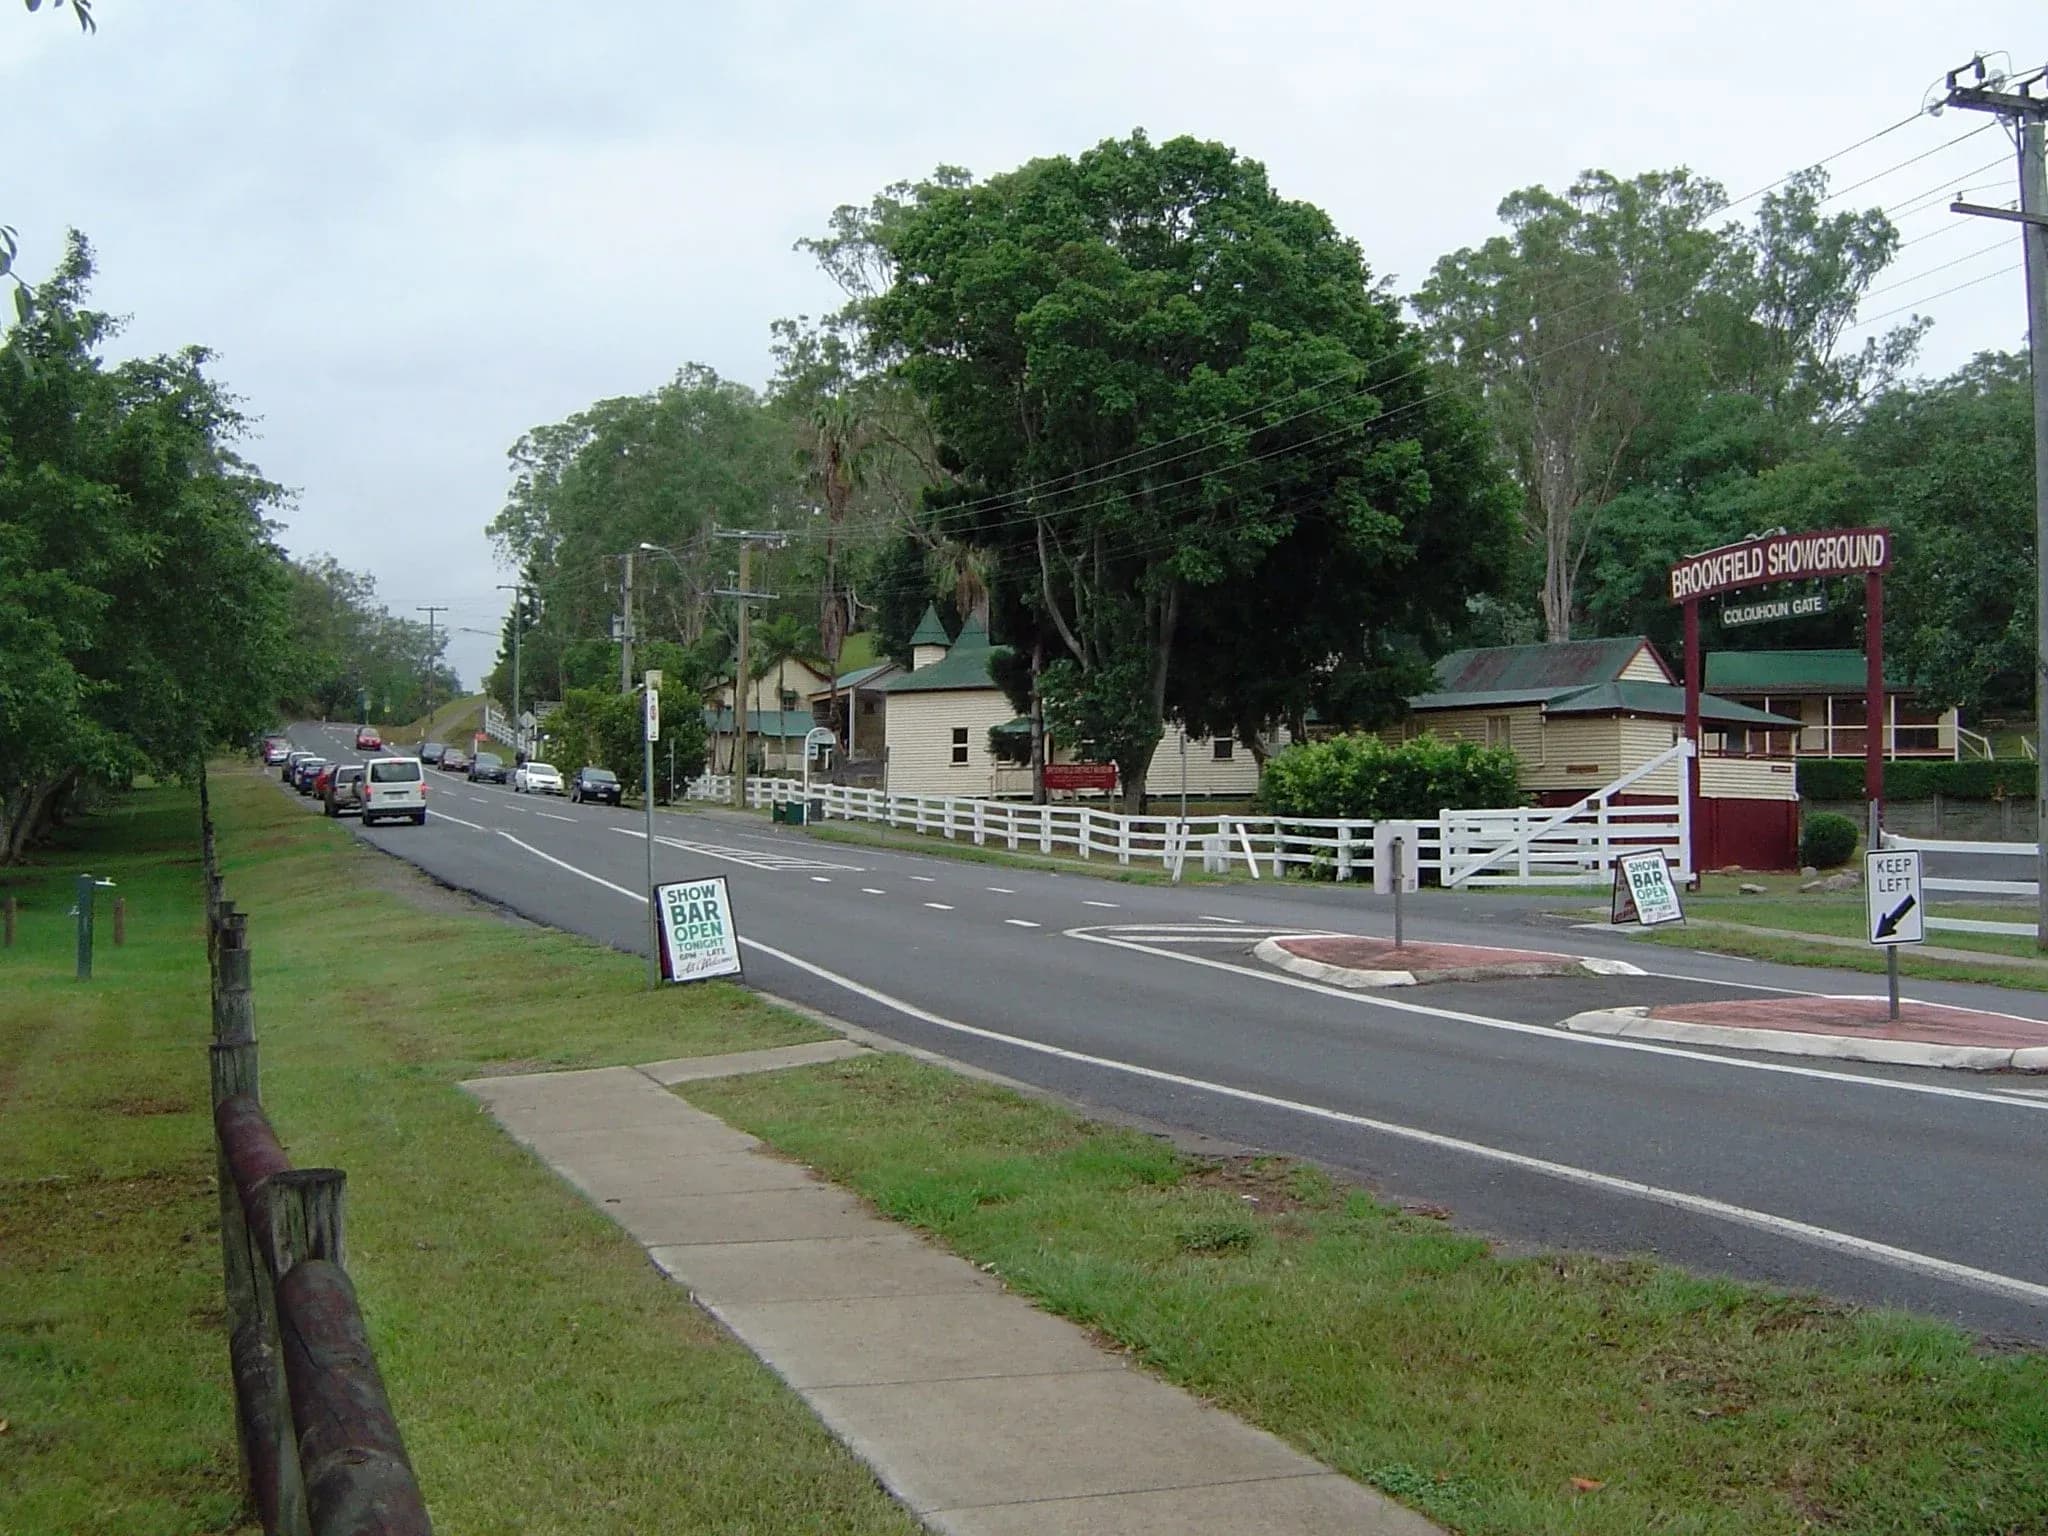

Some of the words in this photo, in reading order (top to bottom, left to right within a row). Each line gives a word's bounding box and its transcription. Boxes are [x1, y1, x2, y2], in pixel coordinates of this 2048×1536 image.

[1672, 548, 1763, 598] BROOKFIELD
[1768, 535, 1884, 575] SHOWGROUND
[1793, 597, 1822, 614] GATE
[1629, 860, 1660, 873] SHOW
[1877, 858, 1911, 872] KEEP
[1633, 871, 1664, 888] BAR
[1879, 877, 1911, 892] LEFT
[668, 885, 715, 904] SHOW
[1637, 886, 1668, 899] OPEN
[670, 900, 720, 926] BAR
[674, 921, 723, 942] OPEN
[676, 937, 725, 952] TONIGHT
